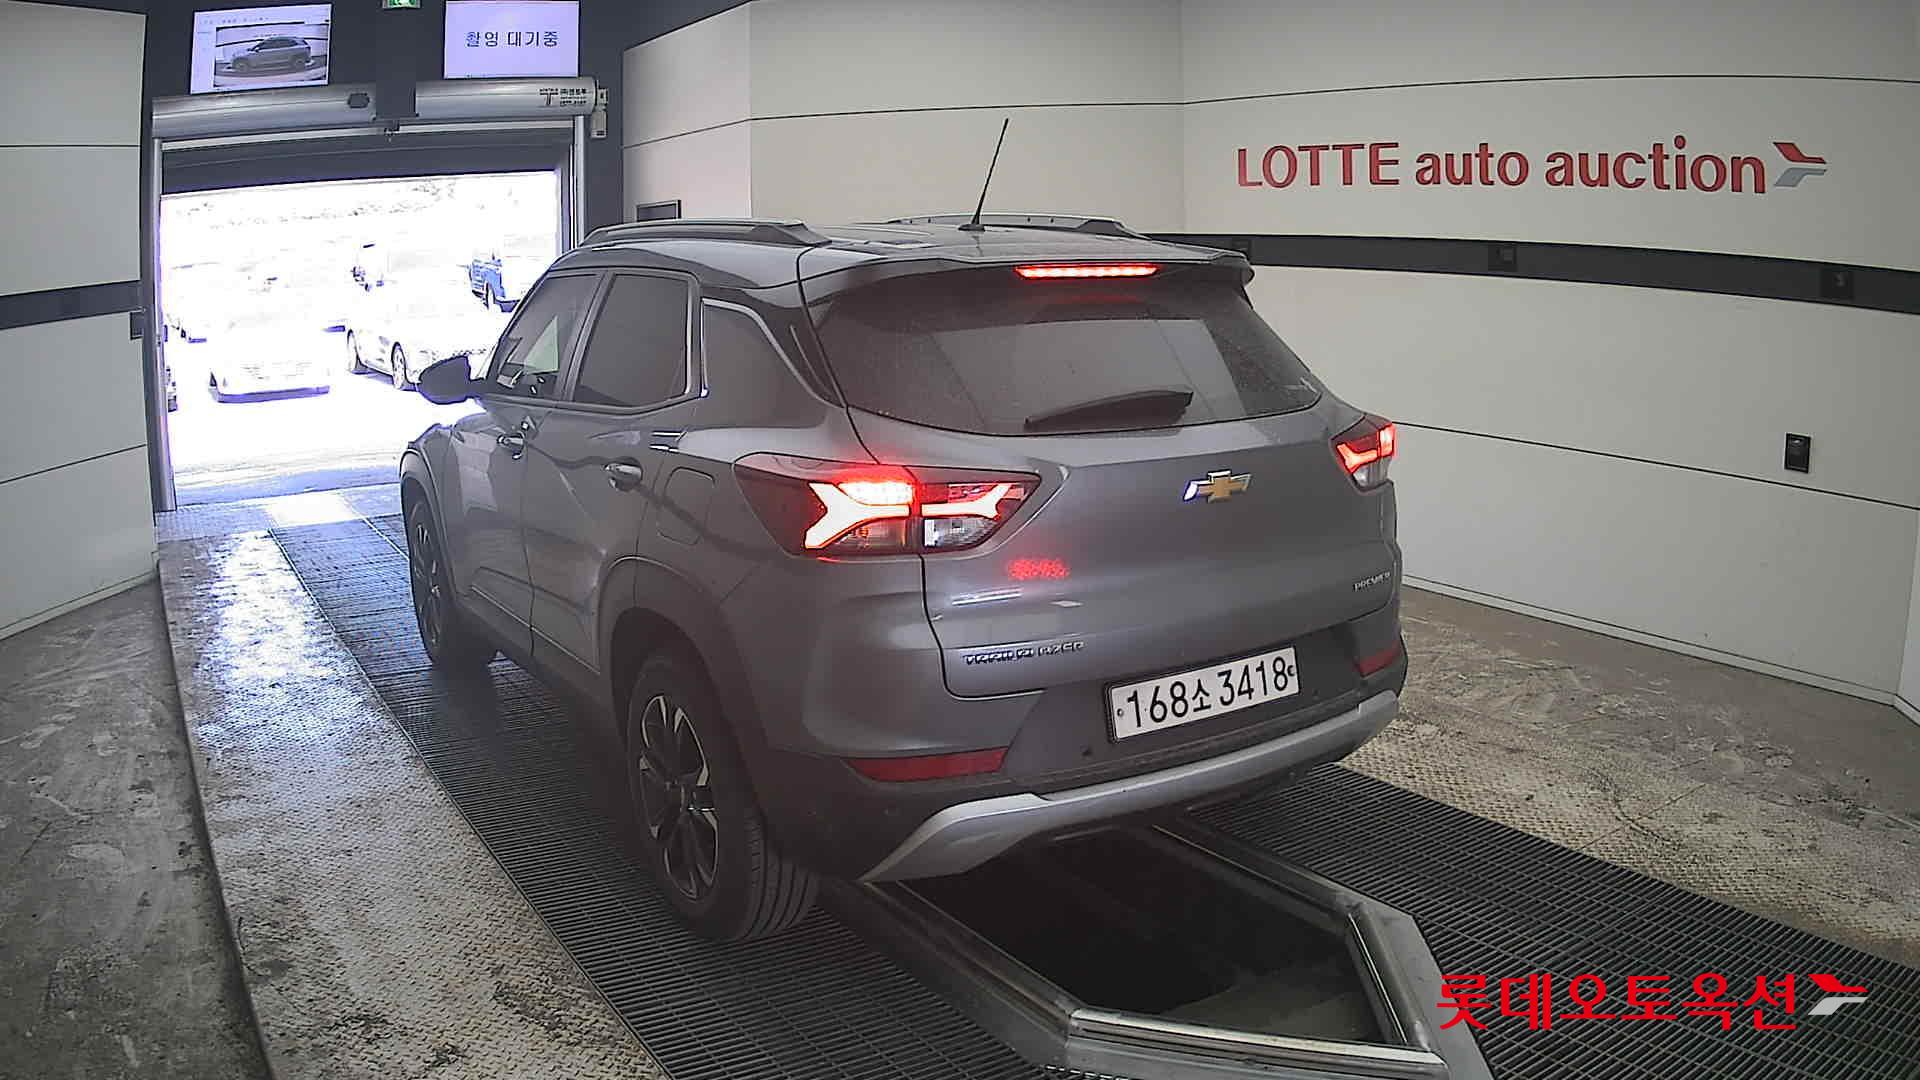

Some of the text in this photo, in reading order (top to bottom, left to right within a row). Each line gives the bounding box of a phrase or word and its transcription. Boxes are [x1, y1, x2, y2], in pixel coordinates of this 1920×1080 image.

[466, 31, 559, 48] 촬영 대기중
[1237, 135, 1767, 194] LOTTE auto auction
